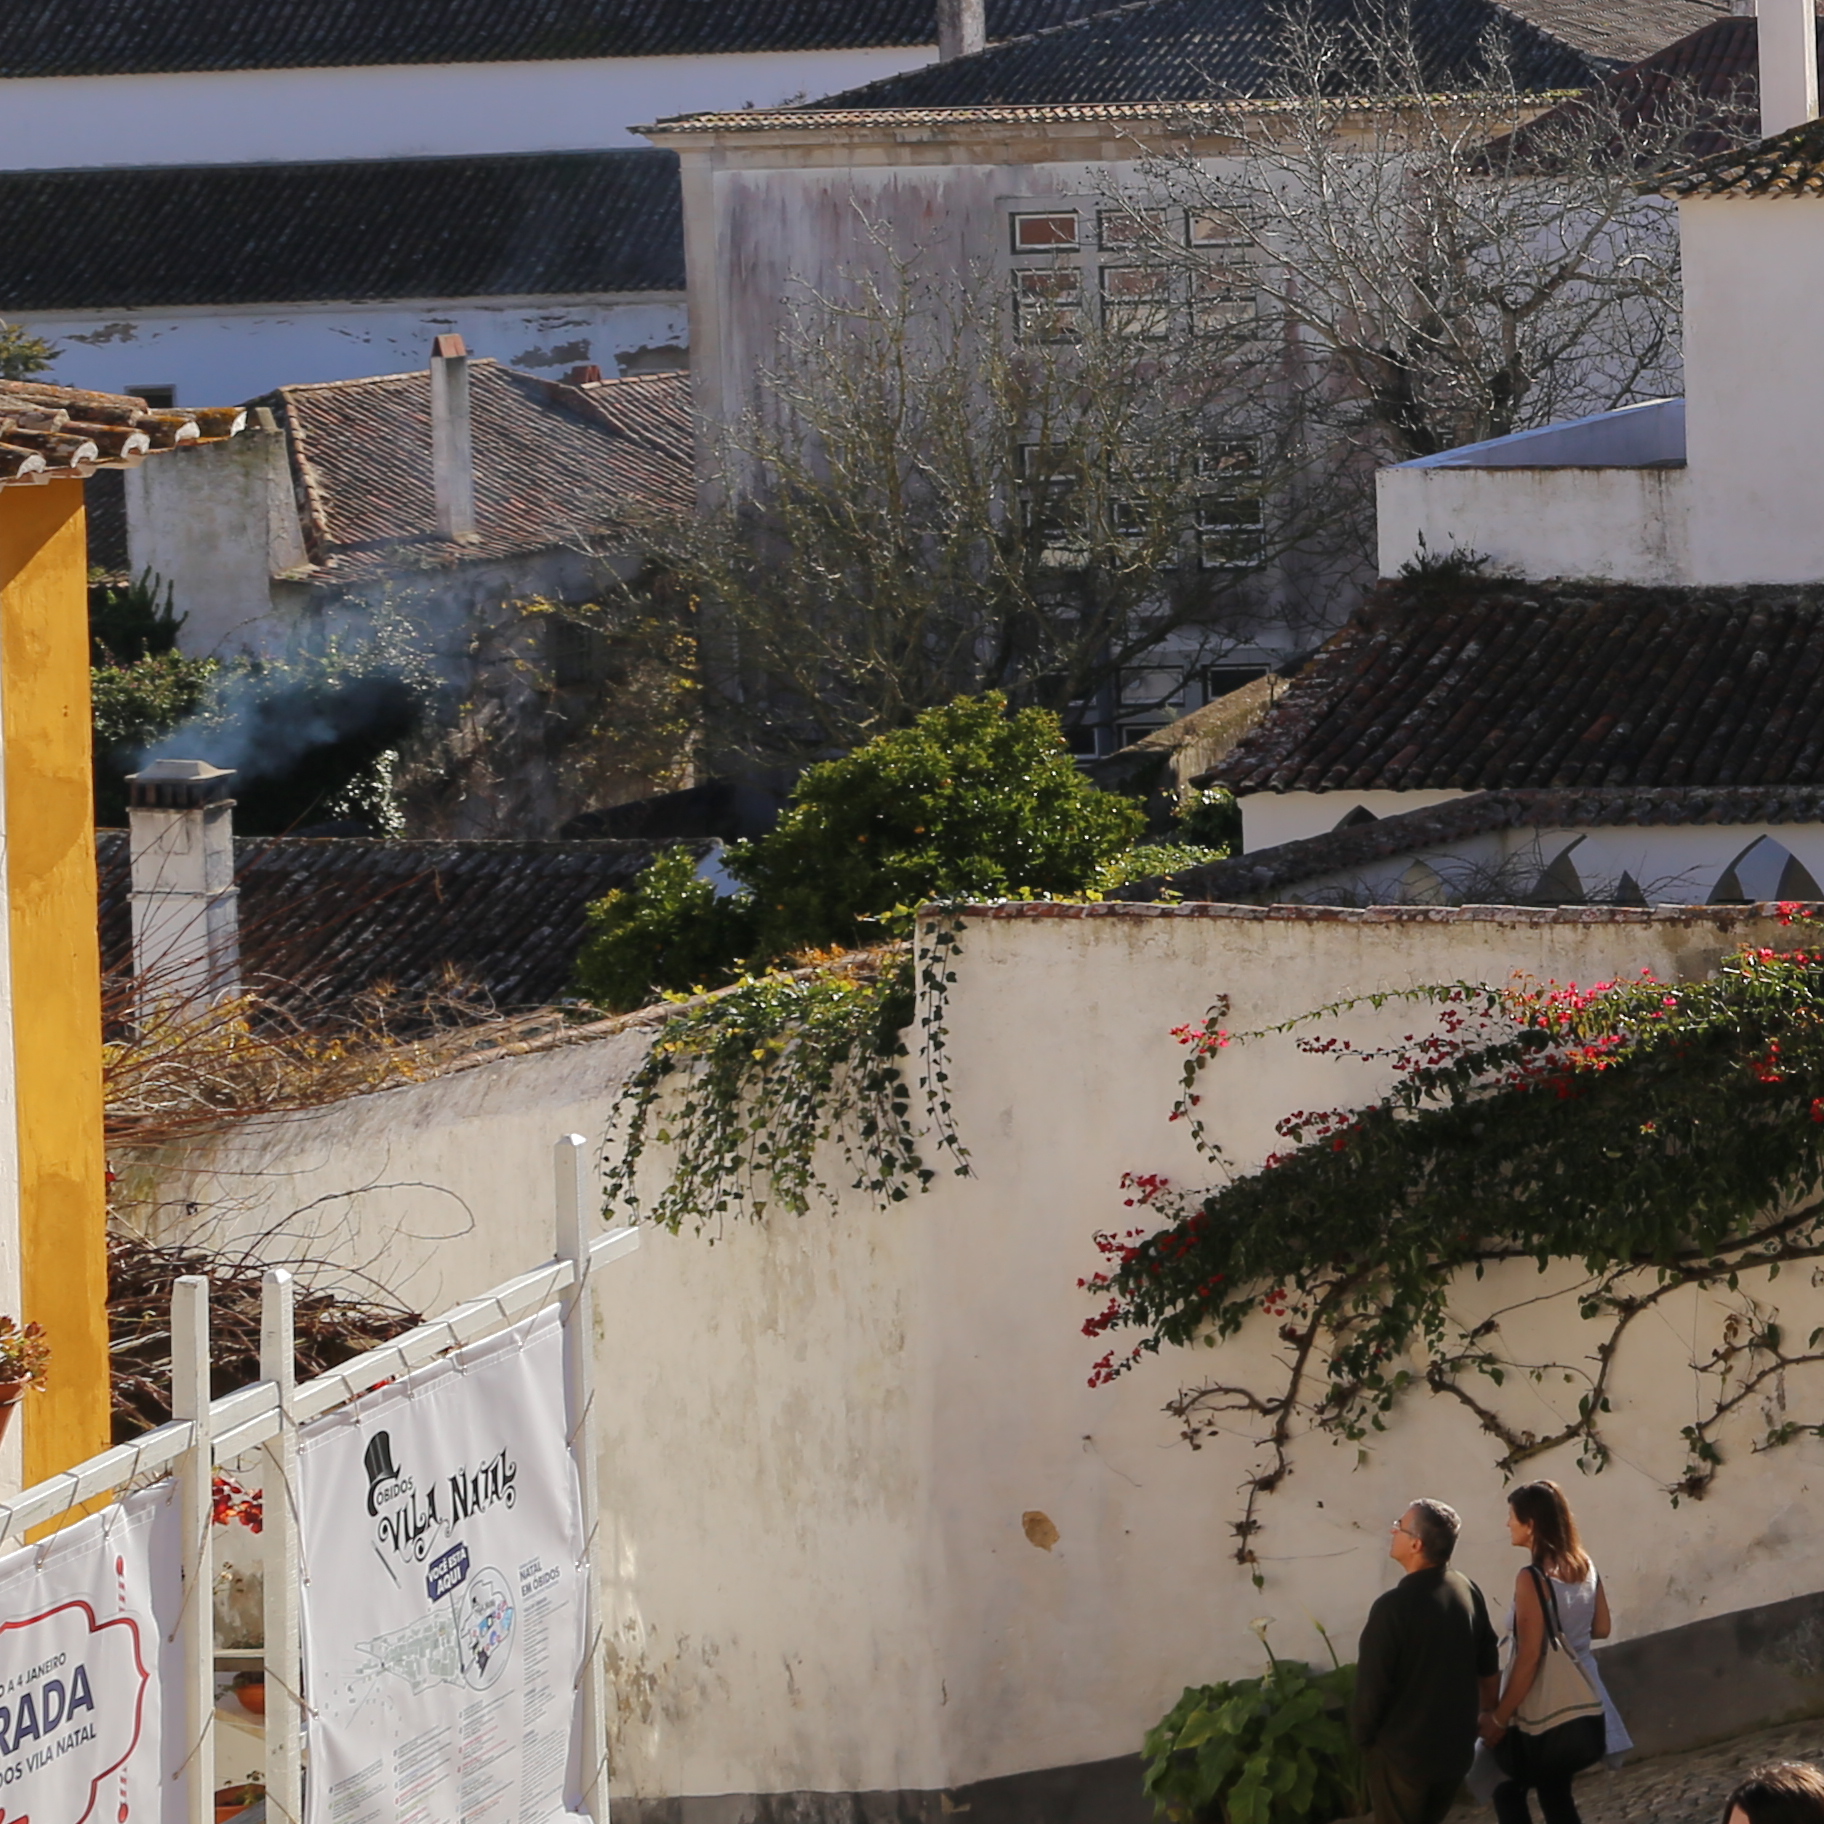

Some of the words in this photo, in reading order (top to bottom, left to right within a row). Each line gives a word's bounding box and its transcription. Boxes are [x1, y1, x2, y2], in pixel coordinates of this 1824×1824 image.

[378, 1480, 443, 1559] VILA
[445, 1446, 516, 1536] NATAL
[436, 1565, 461, 1596] AQUI
[521, 1581, 532, 1597] EM
[7, 1679, 15, 1694] A
[17, 1673, 24, 1687] 4
[25, 1652, 66, 1684] JANEIRO
[26, 1745, 54, 1774] VILA
[56, 1722, 97, 1758] NATAL
